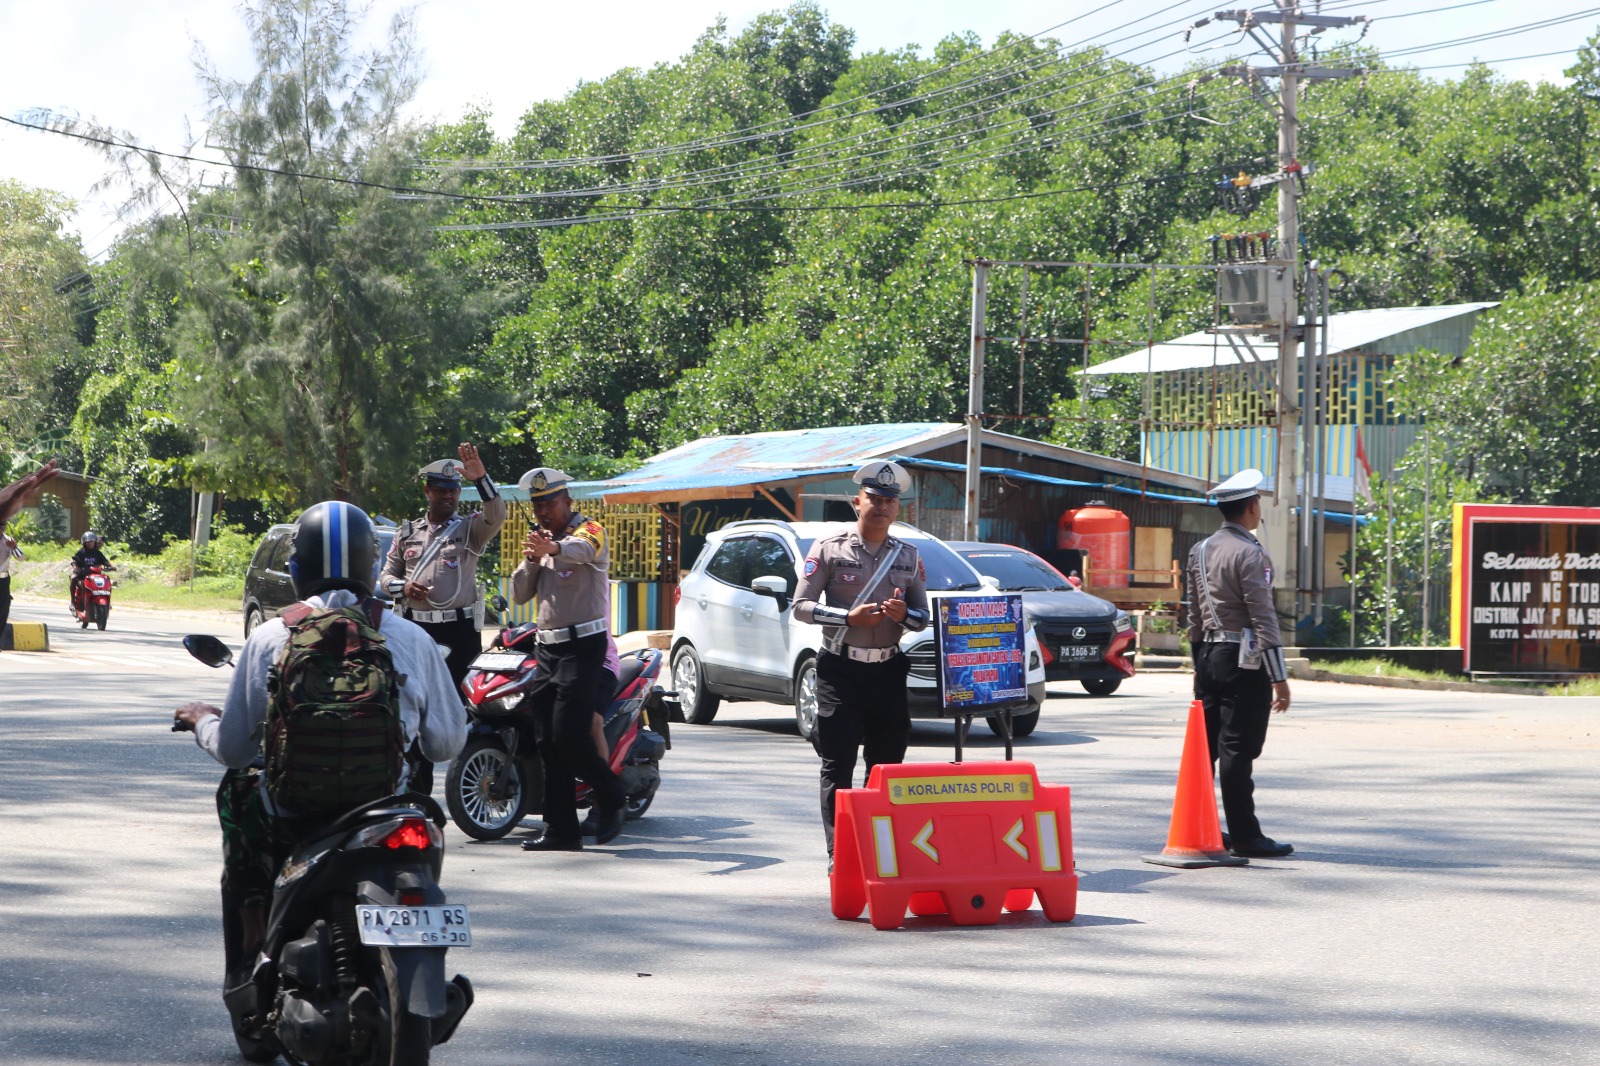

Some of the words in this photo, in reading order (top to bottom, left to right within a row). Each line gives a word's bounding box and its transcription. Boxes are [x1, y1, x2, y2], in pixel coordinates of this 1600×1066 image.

[1482, 551, 1562, 570] Selamat
[1550, 571, 1564, 582] DI
[958, 602, 986, 619] MOHON
[986, 601, 1007, 618] MAAF
[1473, 607, 1520, 624] DISTRIK
[1490, 629, 1520, 639] KOTA
[1061, 647, 1069, 657] PA
[1071, 647, 1088, 656] 1606
[908, 783, 978, 796] KORLANTAS
[981, 782, 1014, 794] POLRI
[363, 910, 384, 926] PA
[390, 910, 430, 926] 2871
[443, 909, 465, 925] RS
